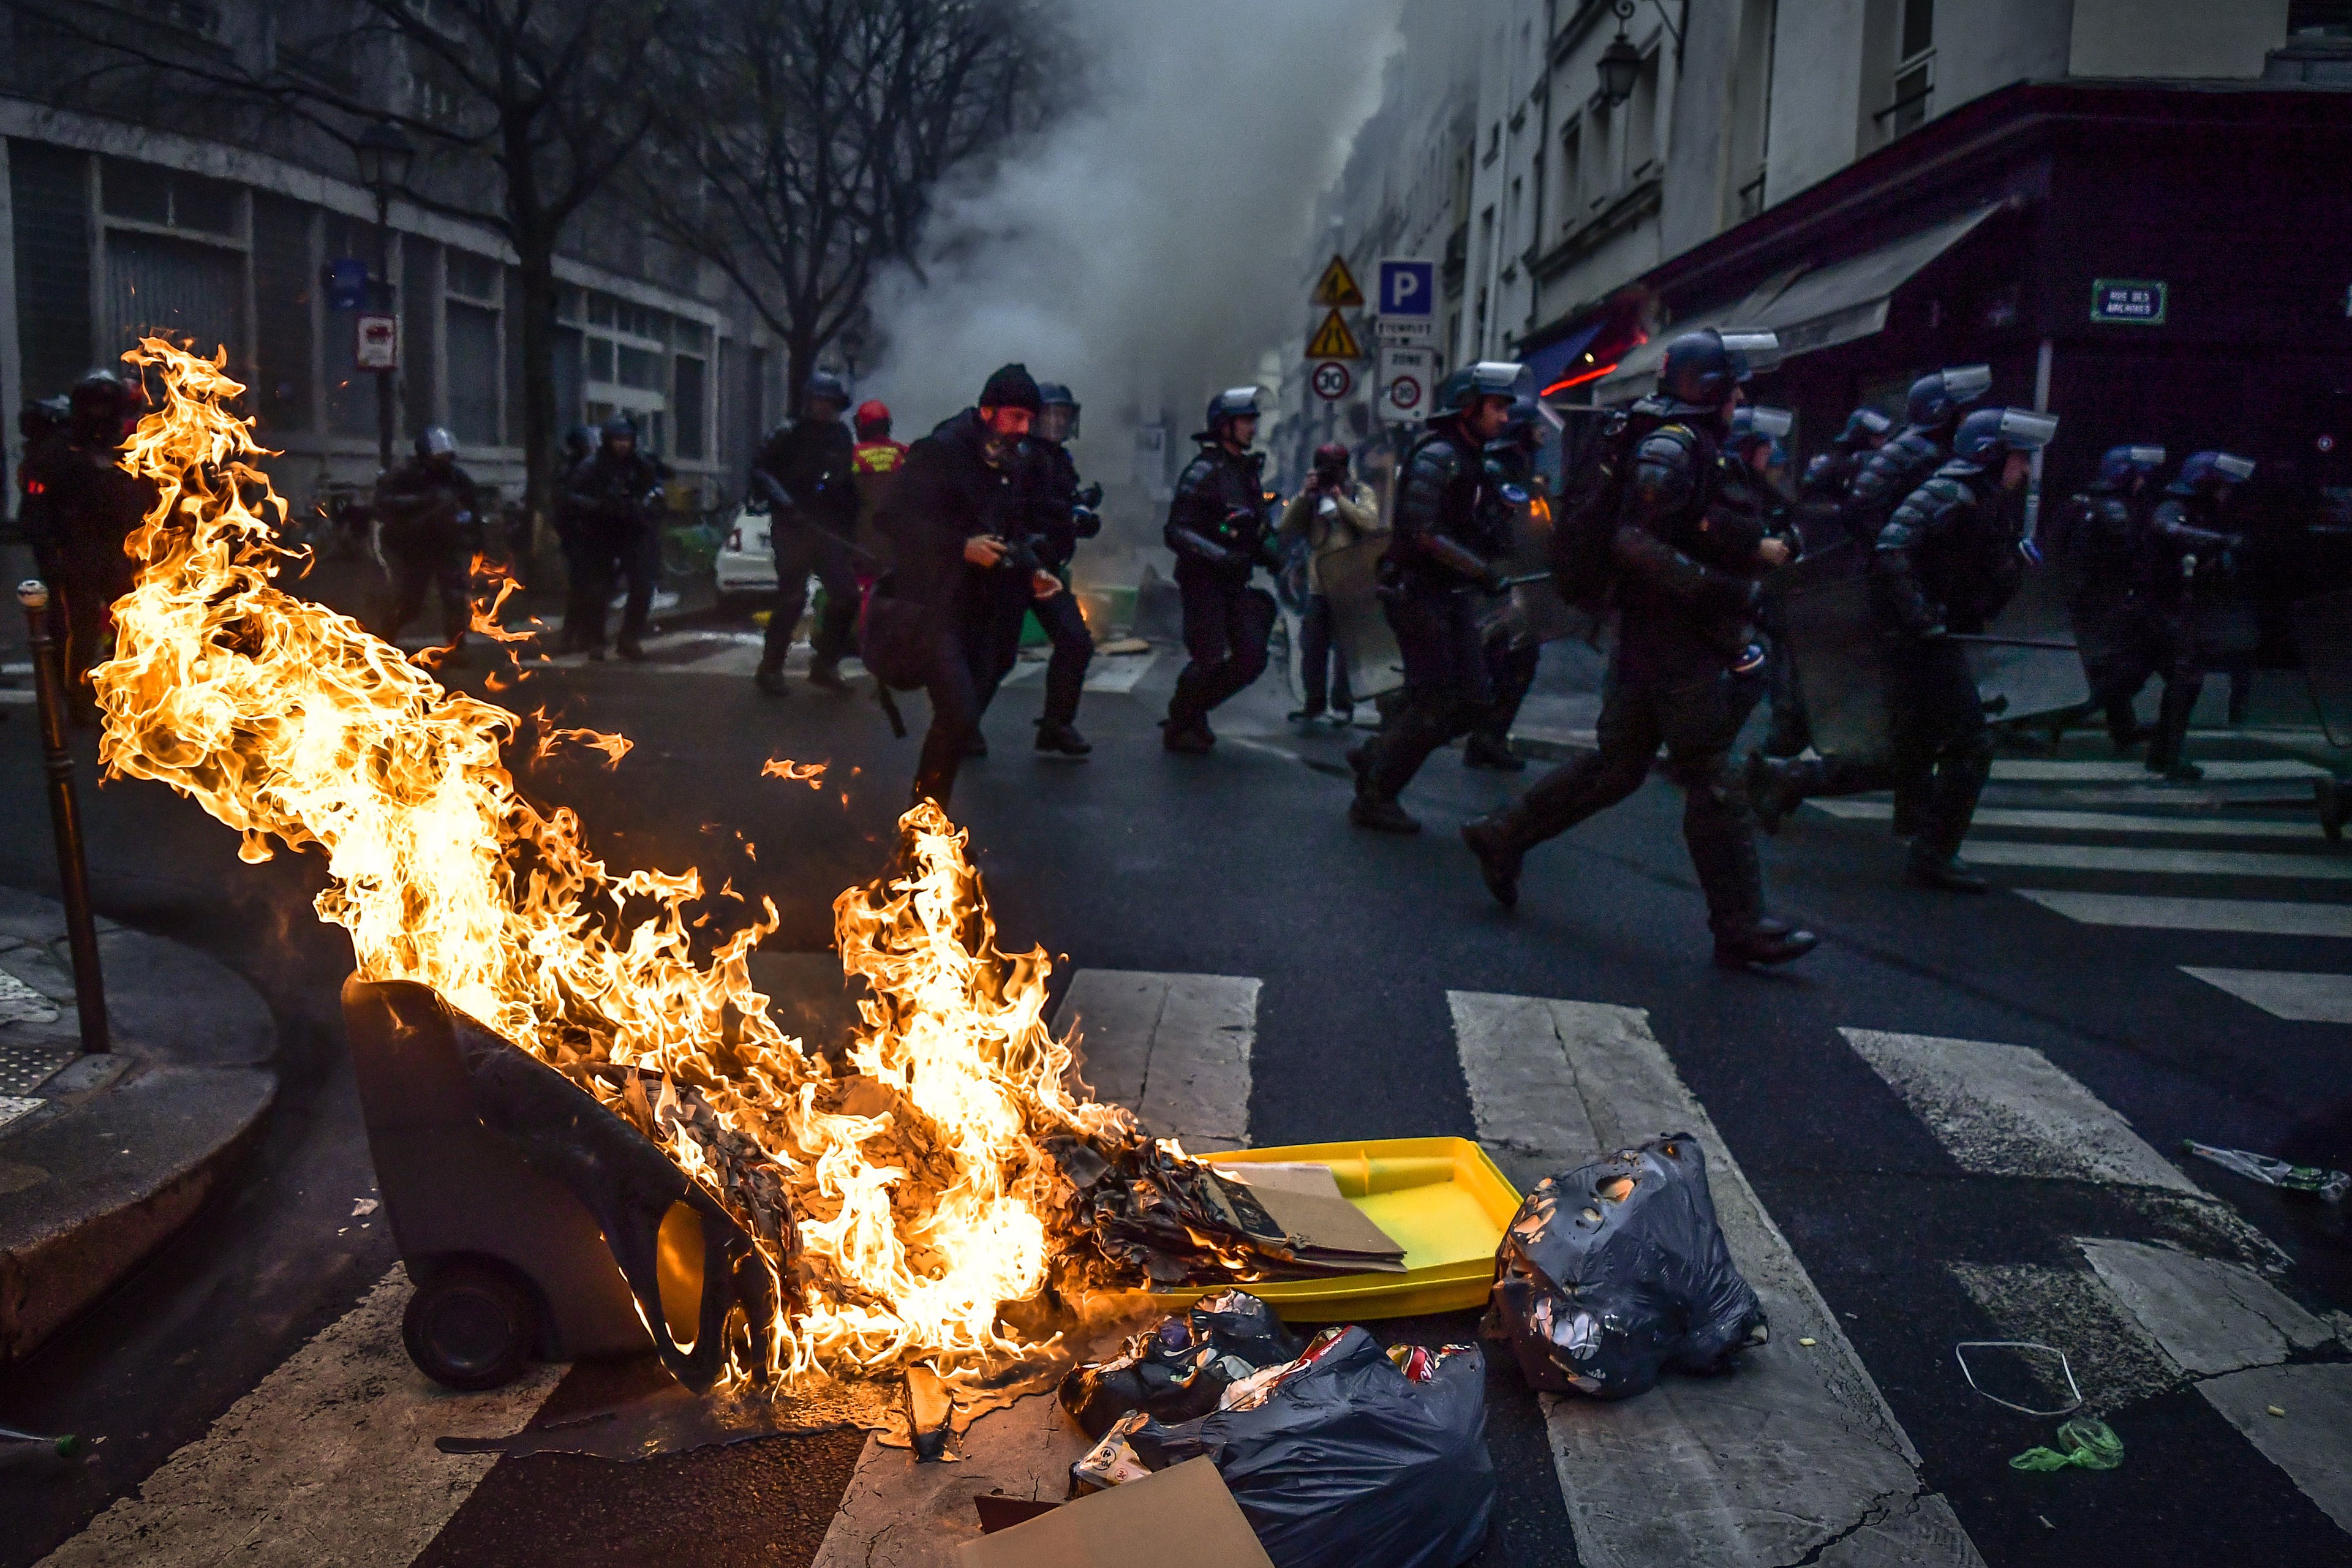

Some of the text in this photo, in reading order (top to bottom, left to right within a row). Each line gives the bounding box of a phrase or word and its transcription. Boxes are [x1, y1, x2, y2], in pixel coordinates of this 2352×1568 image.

[1393, 271, 1419, 307] P
[2109, 290, 2150, 303] RUE DES
[1318, 371, 1343, 390] 30
